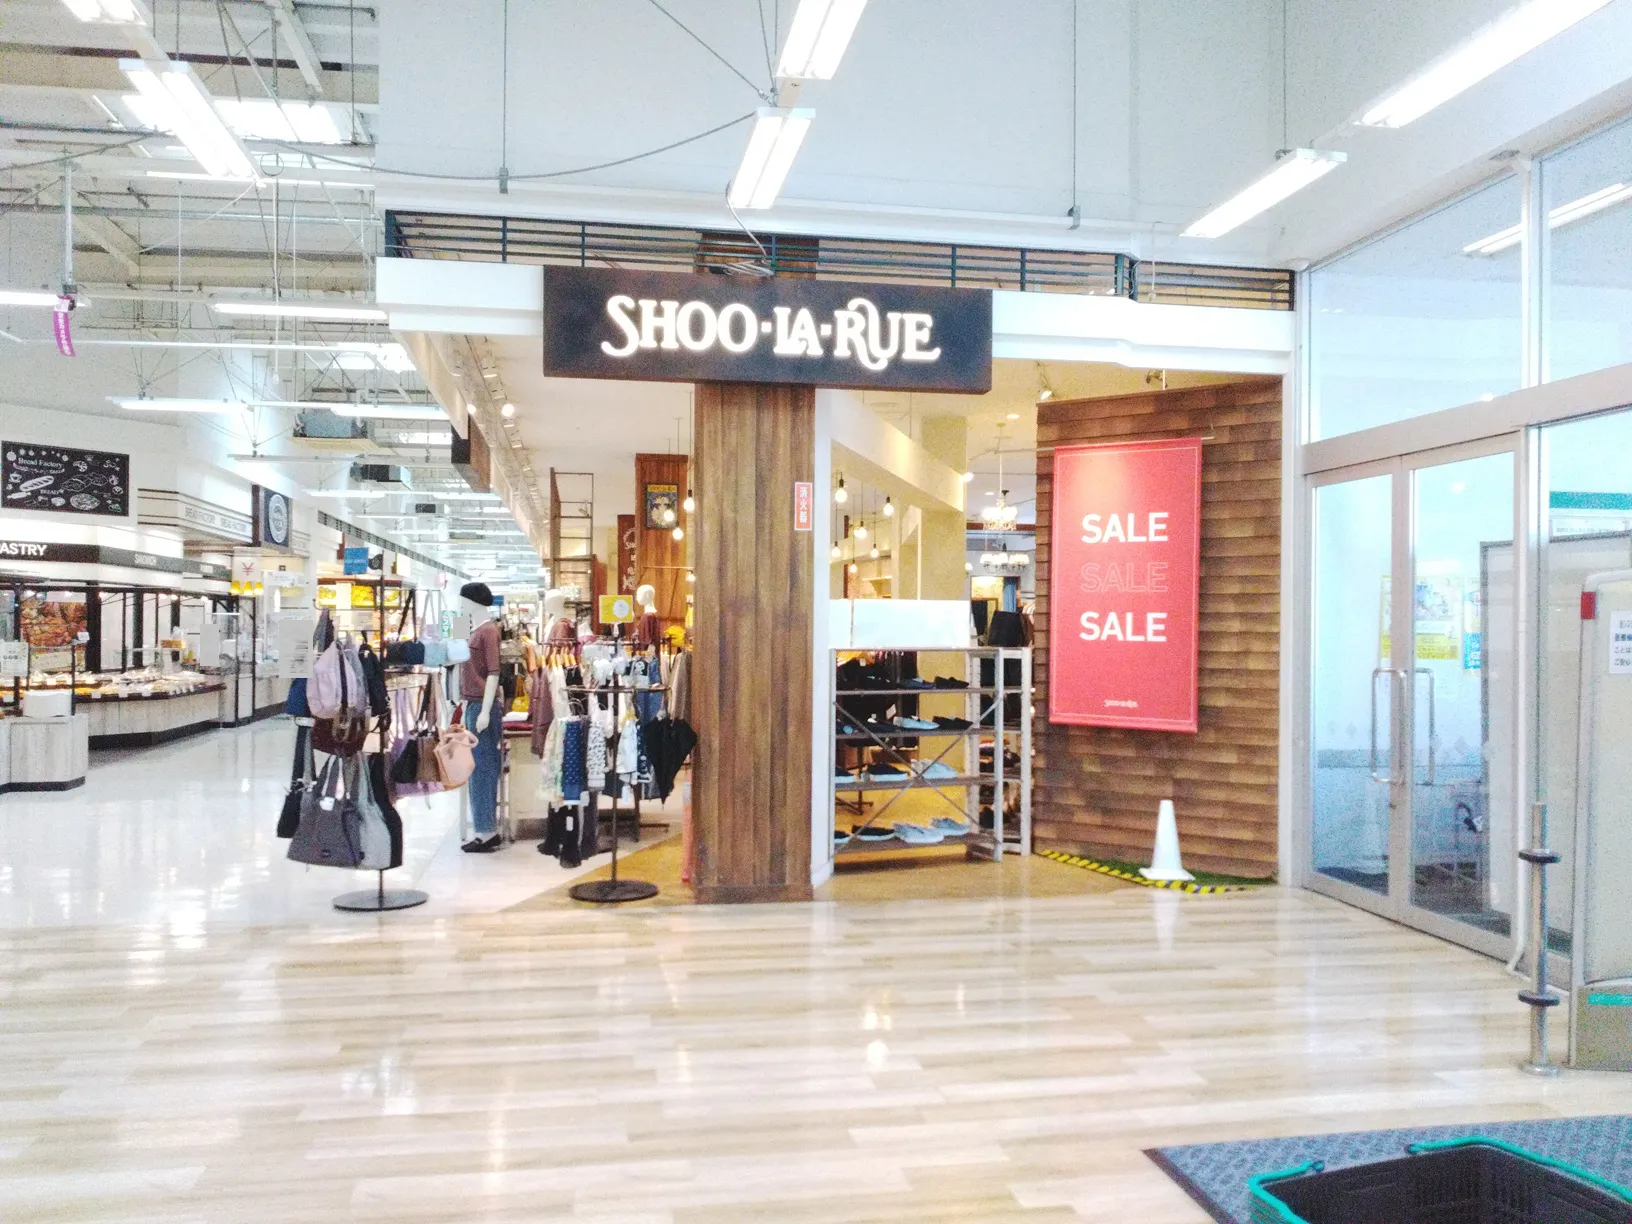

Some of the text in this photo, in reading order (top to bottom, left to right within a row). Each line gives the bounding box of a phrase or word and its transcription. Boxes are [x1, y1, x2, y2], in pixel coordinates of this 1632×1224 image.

[1081, 512, 1169, 544] SALE
[0, 542, 47, 556] ASTRY
[1080, 562, 1169, 593] SALE
[1079, 611, 1168, 643] SALE
